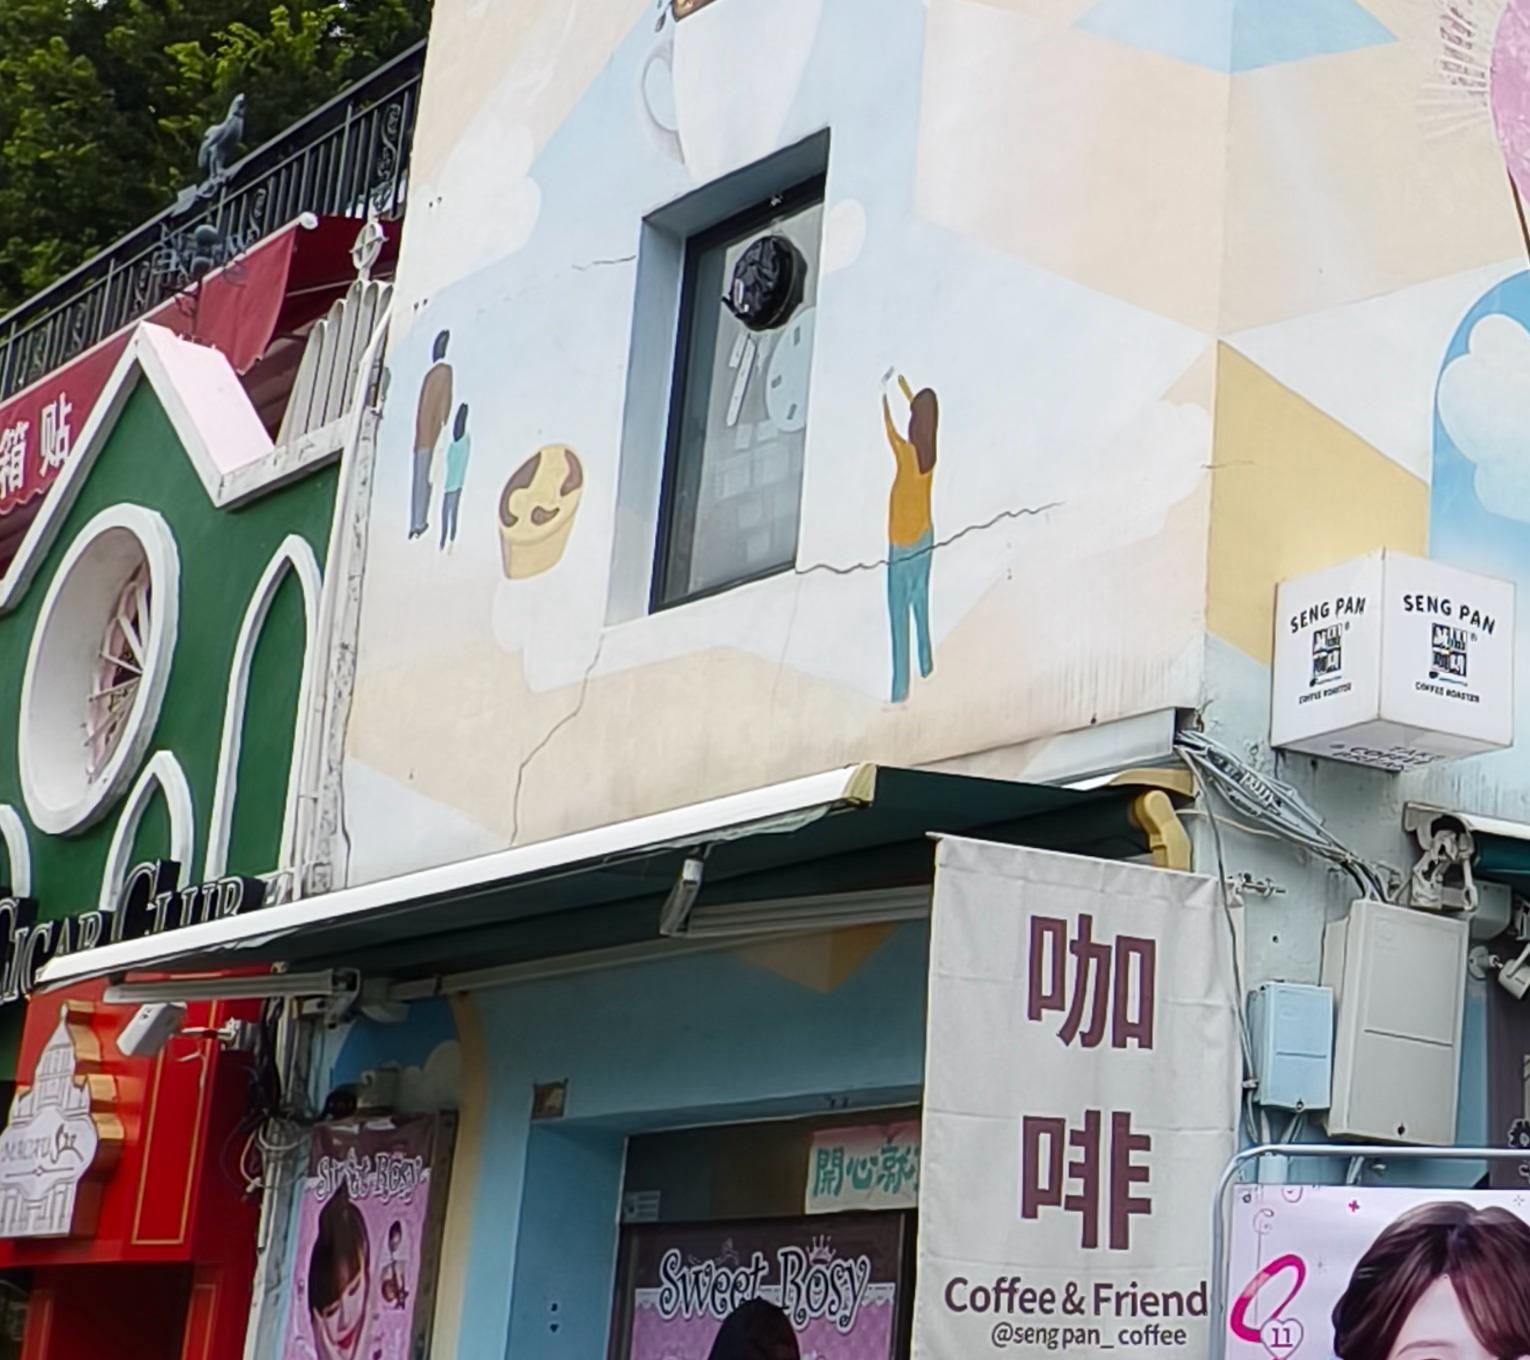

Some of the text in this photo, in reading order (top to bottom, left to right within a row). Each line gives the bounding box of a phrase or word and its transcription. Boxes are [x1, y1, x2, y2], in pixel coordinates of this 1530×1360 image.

[1289, 595, 1366, 633] SENG PAN
[1403, 594, 1496, 636] SENG PAN
[1021, 913, 1156, 1250] 咖啡
[813, 1145, 920, 1197] 開心就
[659, 1245, 872, 1332] Sweet Rosy
[944, 1276, 1208, 1317] Coffee & Friend
[1271, 1327, 1293, 1348] 11
